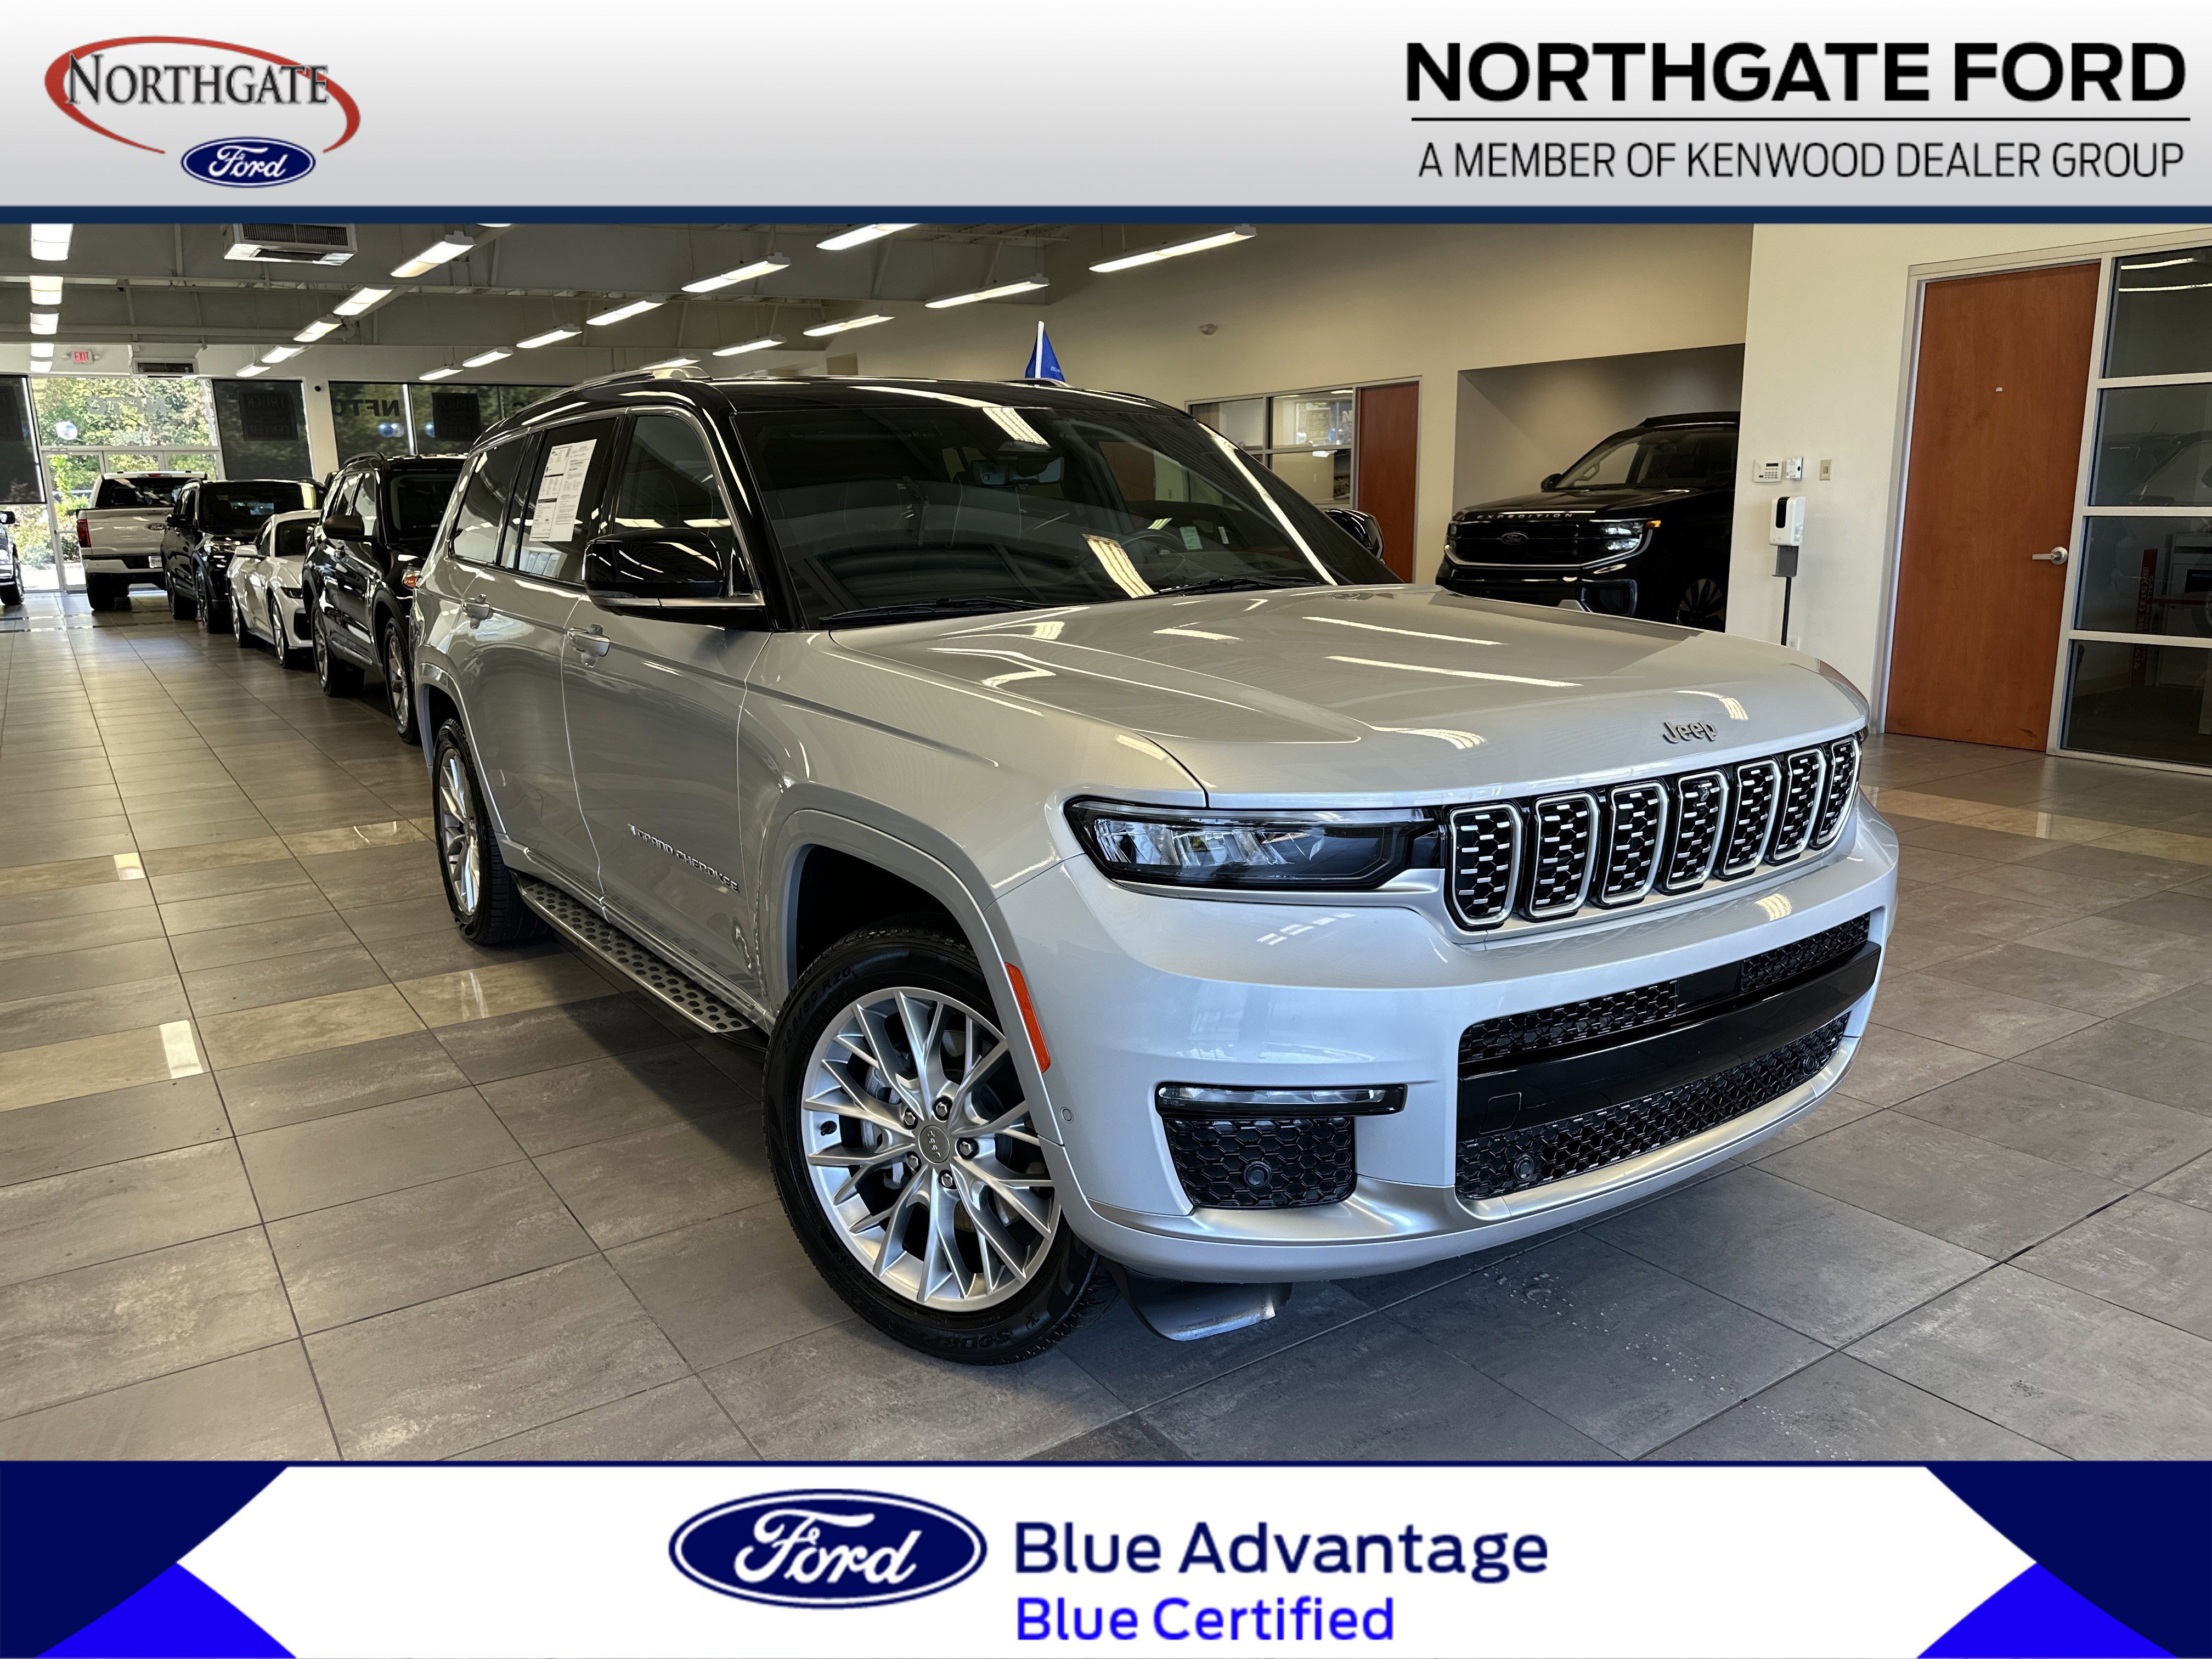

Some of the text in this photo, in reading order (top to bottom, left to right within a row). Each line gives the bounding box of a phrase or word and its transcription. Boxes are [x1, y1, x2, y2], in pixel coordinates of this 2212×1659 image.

[74, 351, 89, 362] EXIT
[1662, 721, 1718, 744] Jeep
[637, 828, 740, 893] GRAND CHEROKEE
